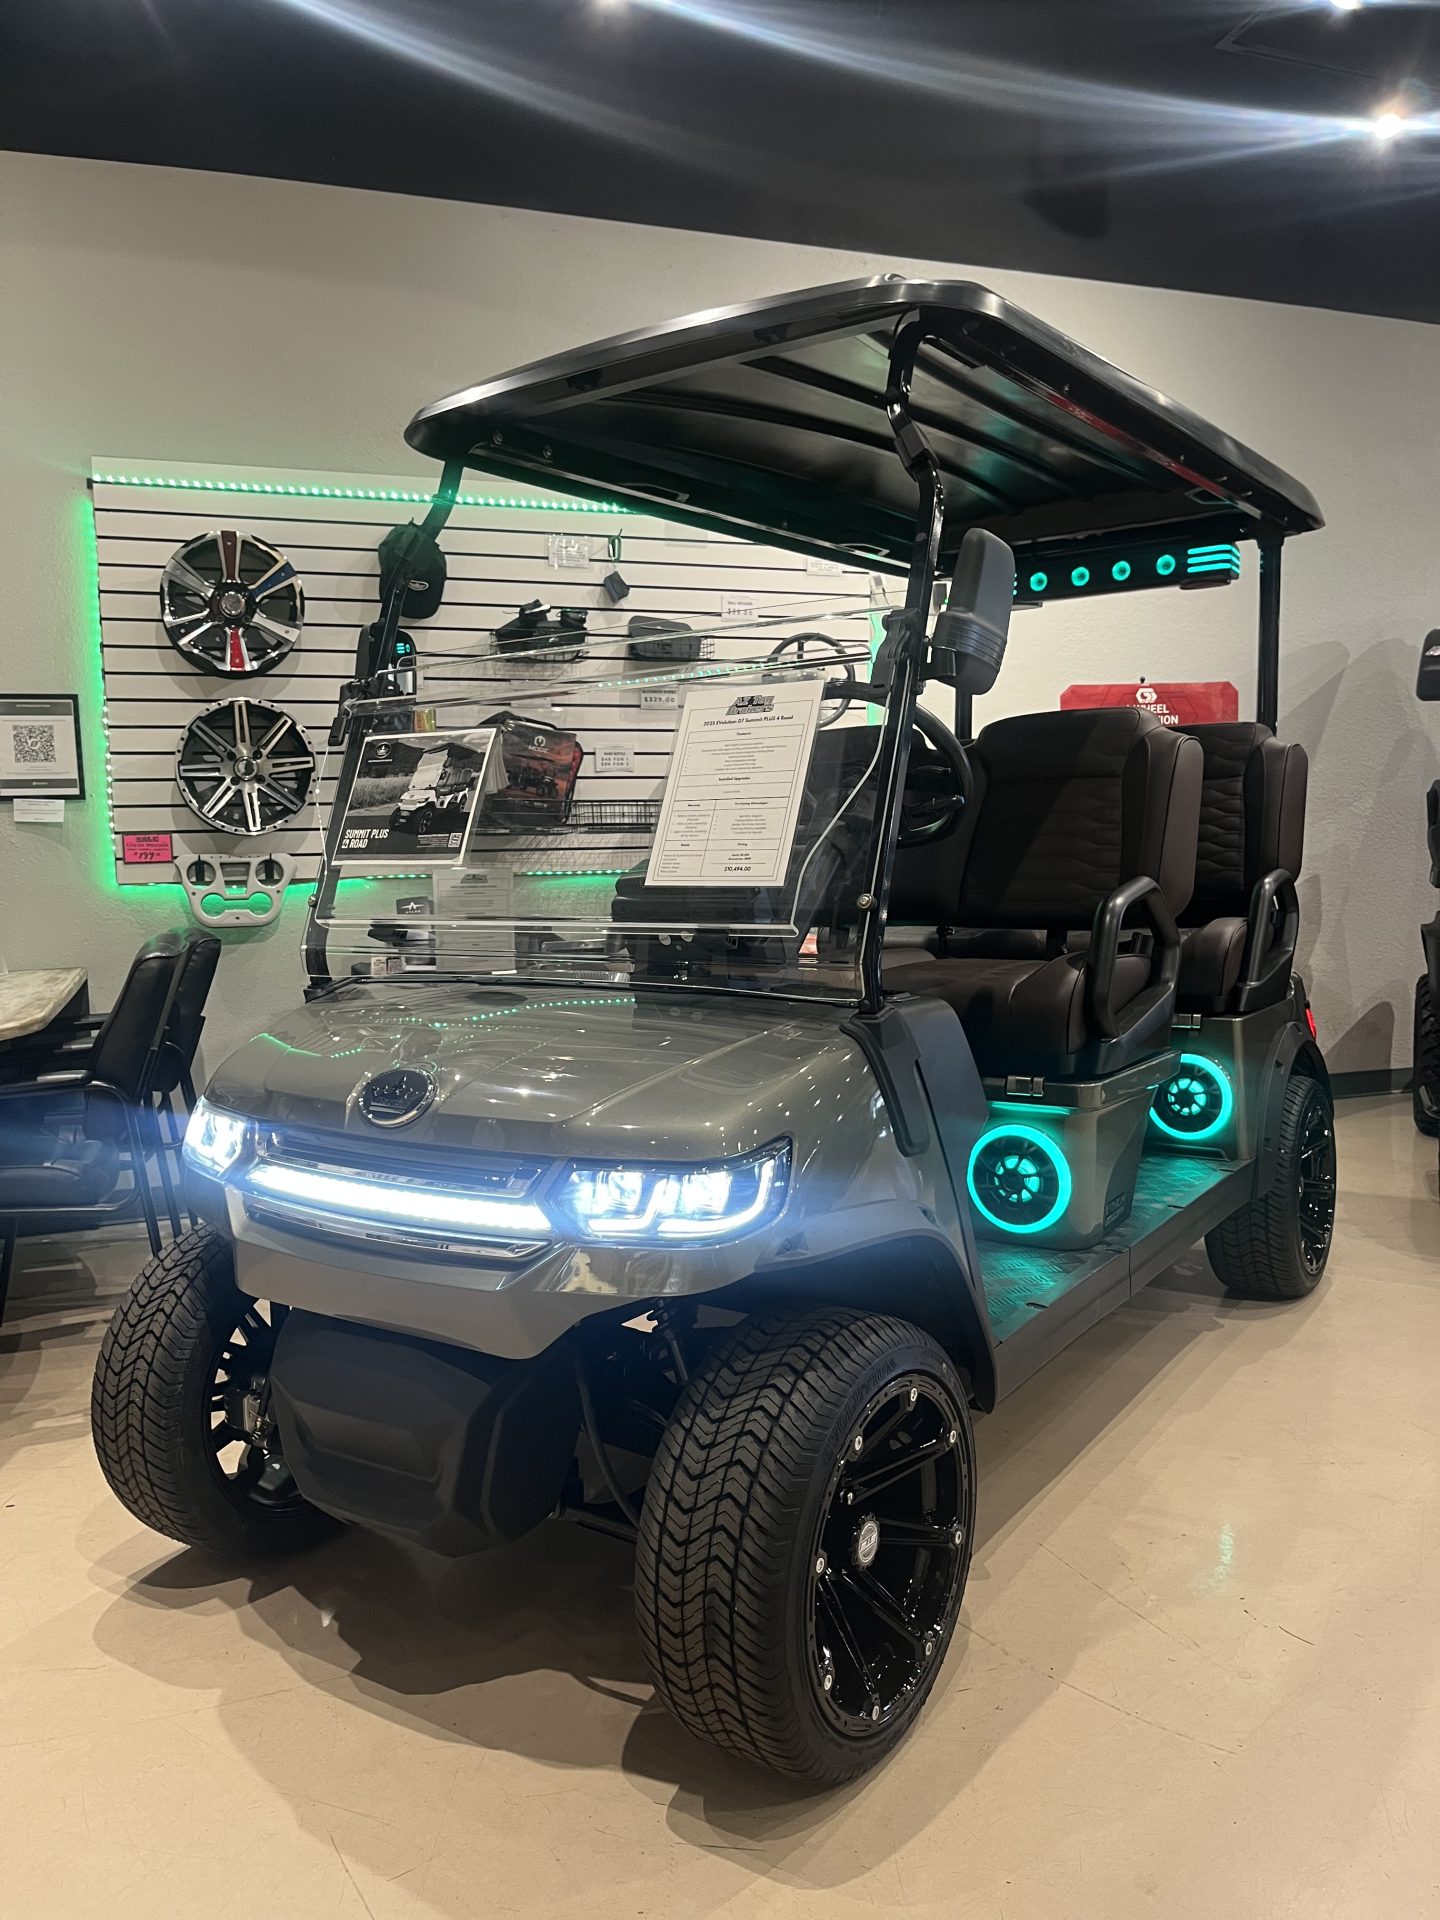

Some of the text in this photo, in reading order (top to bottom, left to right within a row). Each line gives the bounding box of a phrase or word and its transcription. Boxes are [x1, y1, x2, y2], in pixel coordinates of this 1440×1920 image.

[1133, 703, 1170, 713] EEL
[344, 828, 390, 839] SUMMIT PLUS
[349, 838, 369, 849] ROAD
[723, 865, 752, 873] $10,494.00
